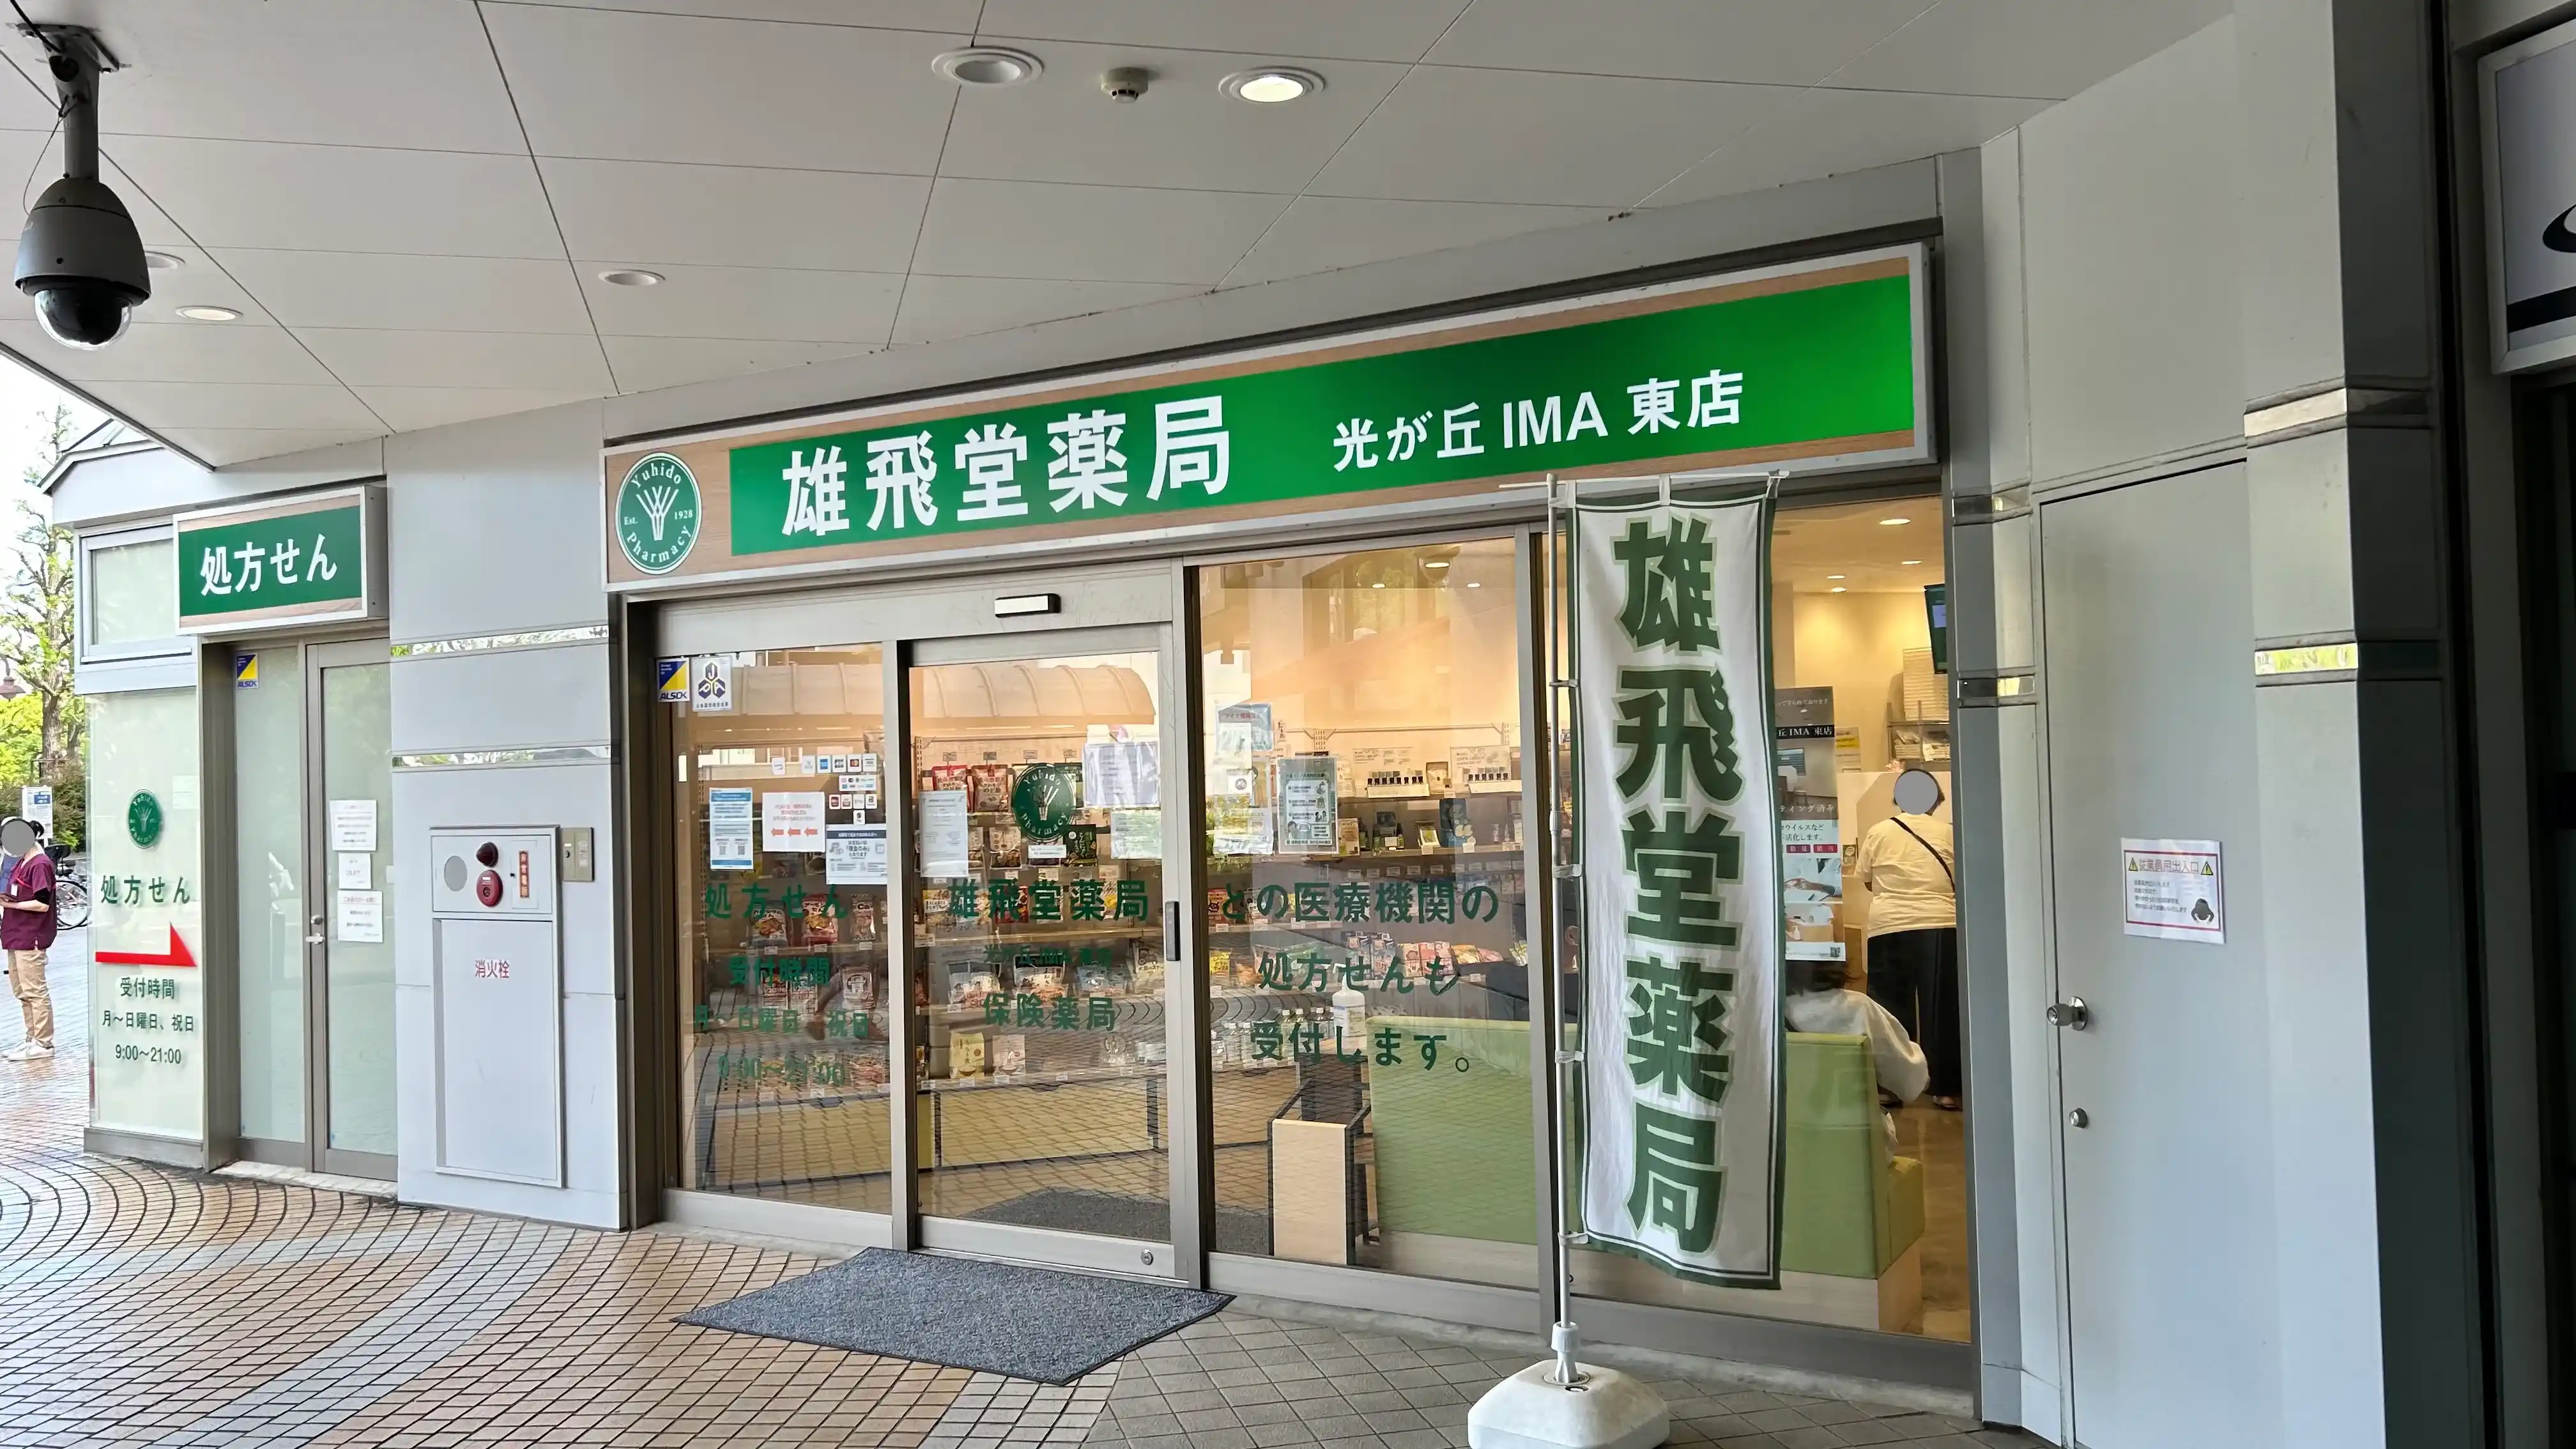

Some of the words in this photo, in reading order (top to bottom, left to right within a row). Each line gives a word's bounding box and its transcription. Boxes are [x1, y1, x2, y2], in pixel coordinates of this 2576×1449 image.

[1333, 402, 1485, 472] 光が丘
[1503, 391, 1609, 448] IMA
[1627, 369, 1744, 435] 東店
[631, 463, 682, 488] Yuhido
[781, 395, 1231, 537] 雄飛堂薬局
[674, 509, 693, 520] 1928
[626, 525, 691, 564] Pharmacy
[200, 533, 337, 597] 処方せん
[659, 691, 688, 700] ALSOK
[1789, 727, 1810, 737] IMA
[1814, 726, 1832, 736] 東店
[1023, 769, 1061, 785] Yuhido
[2139, 858, 2200, 874] 従業員用出入口
[100, 873, 191, 905] 処方せん
[706, 882, 849, 920] 処方せん
[947, 878, 1149, 922] 雄飛堂薬局
[1611, 516, 1744, 1255] 雄飛堂薬局
[119, 976, 175, 1000] 受付時間
[475, 960, 510, 979] 消火栓
[1257, 951, 1461, 996] 処方せんも
[983, 993, 1115, 1031] 保険薬局
[1250, 1022, 1469, 1073] 受付します。
